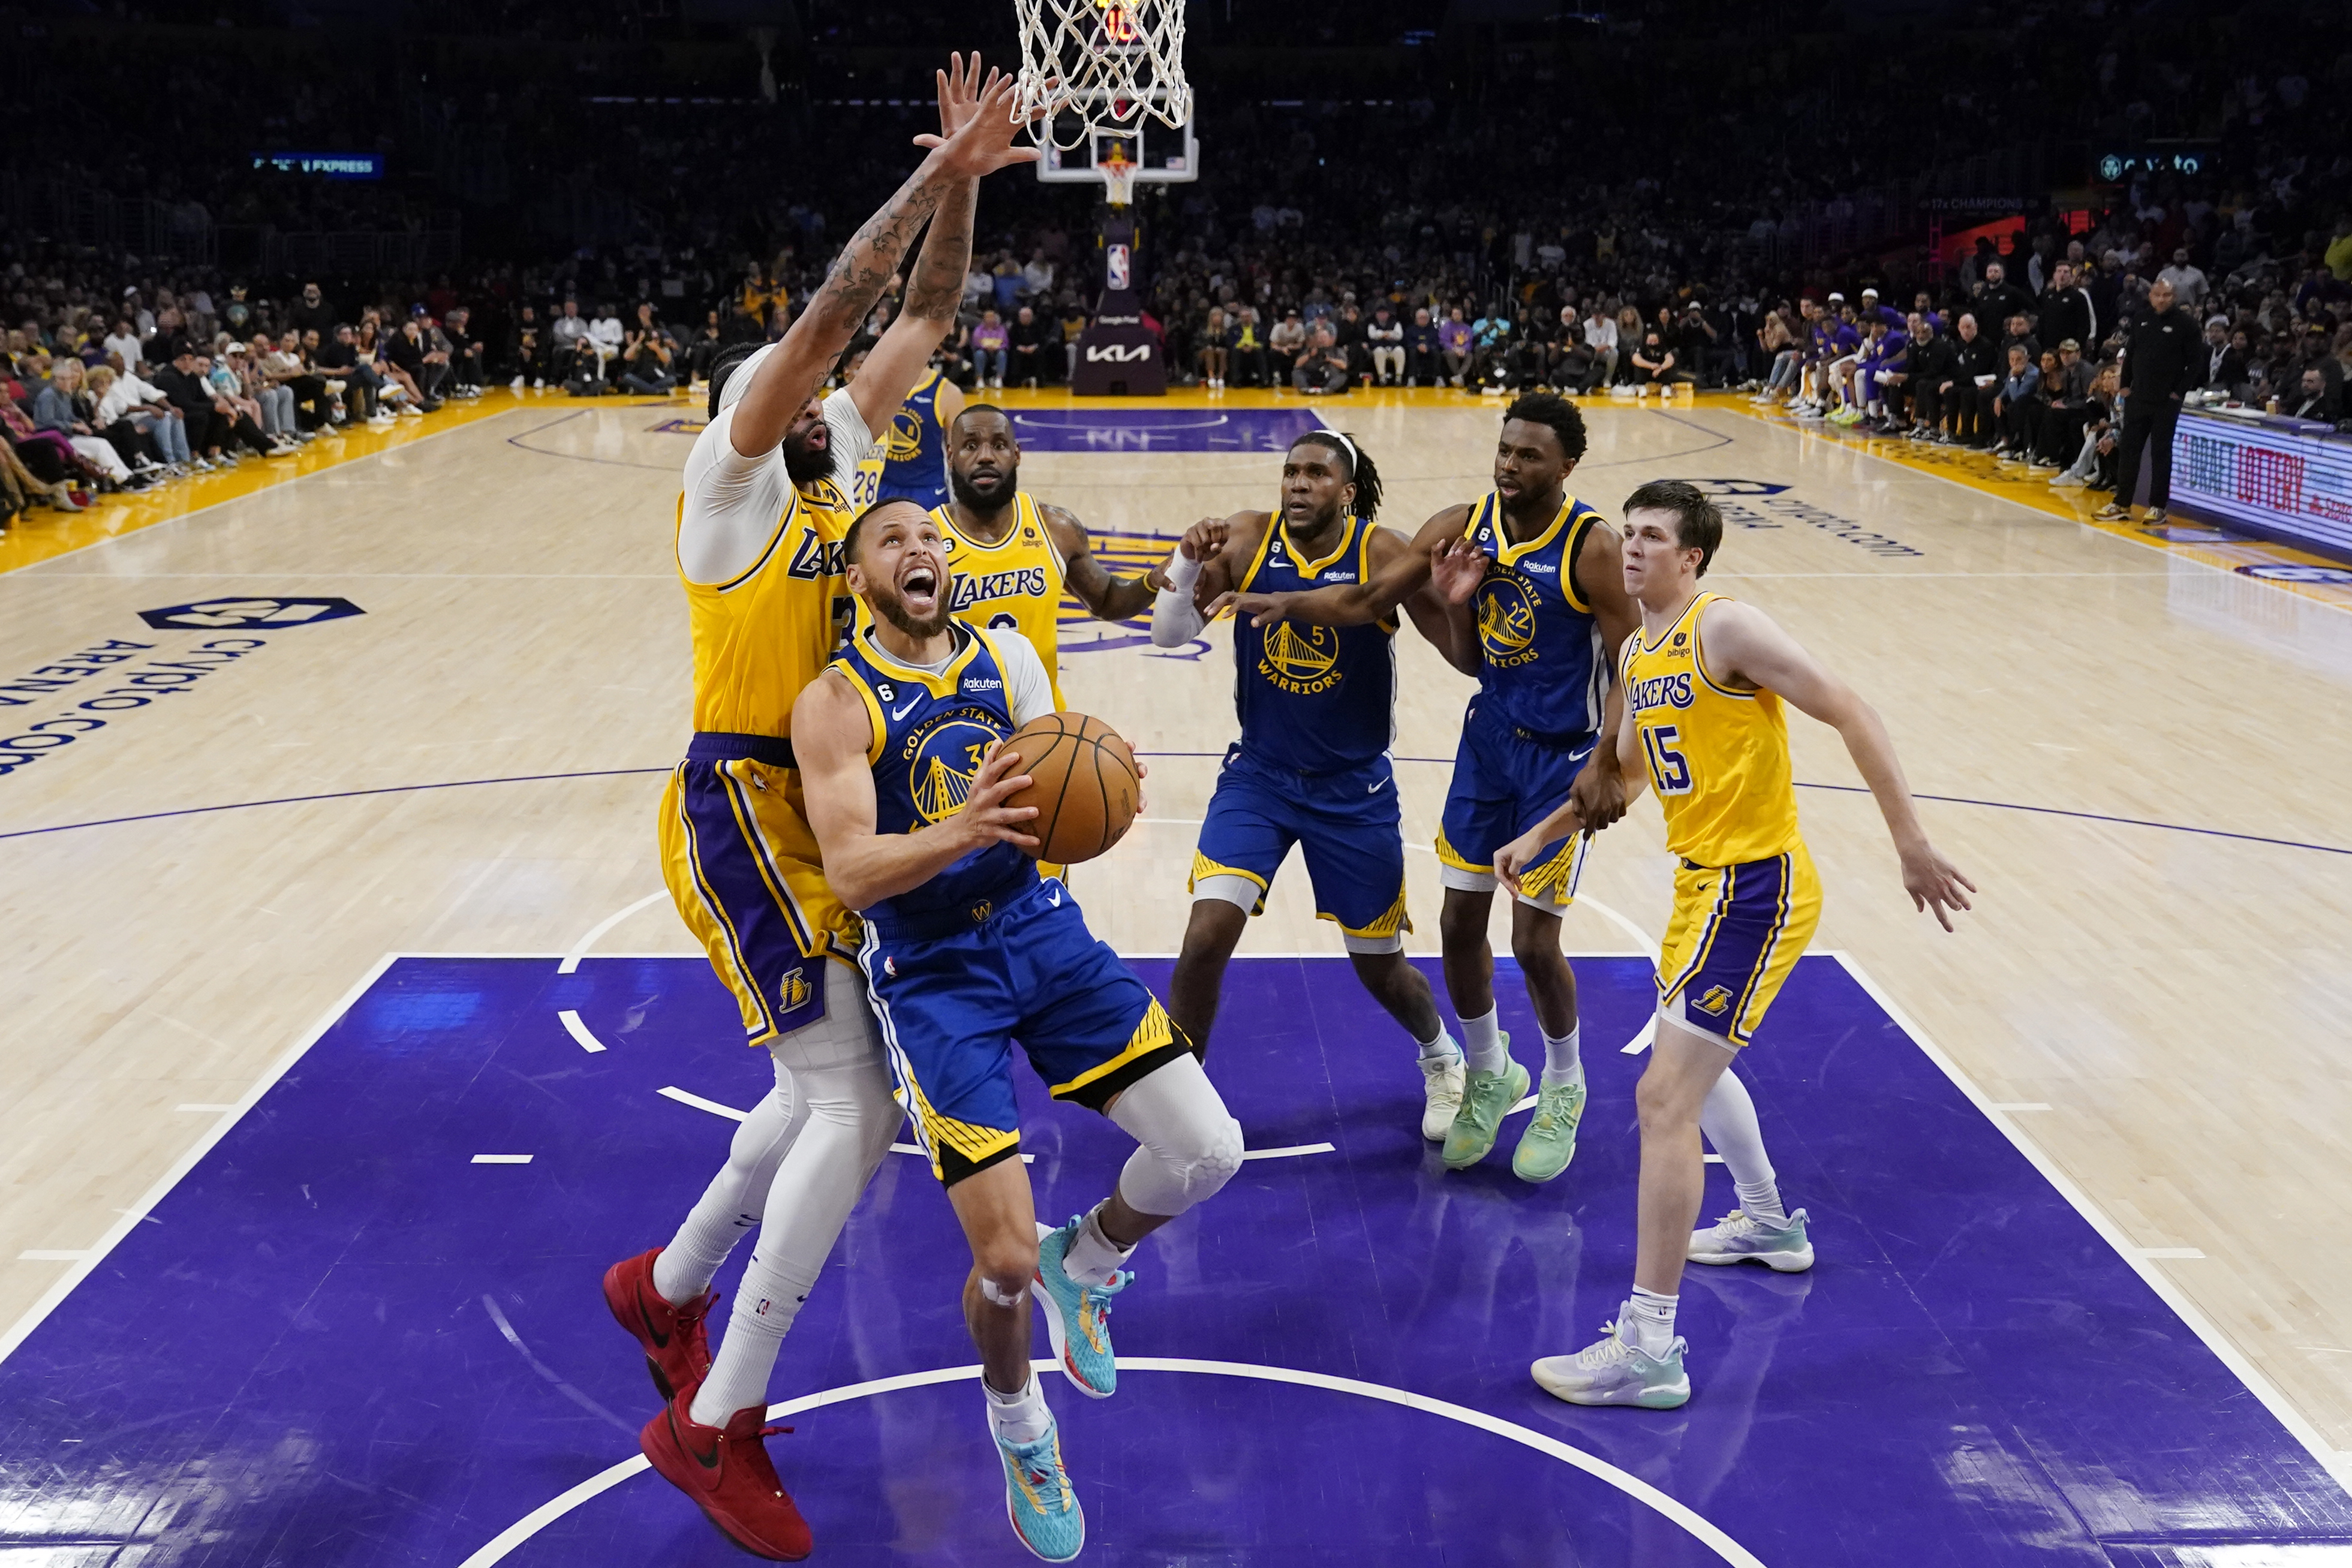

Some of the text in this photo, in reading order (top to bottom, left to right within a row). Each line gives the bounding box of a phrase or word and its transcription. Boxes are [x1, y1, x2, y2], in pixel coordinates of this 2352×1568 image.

[1951, 198, 2023, 209] CHAMPIONS
[853, 471, 877, 504] 28
[1271, 541, 1282, 553] 6
[1478, 528, 1491, 542] 6
[787, 526, 847, 581] LAK
[1324, 571, 1355, 580] Rakuten
[1523, 560, 1556, 573] Rakuten
[949, 567, 1047, 614] LAKERS
[1517, 576, 1542, 607] STATE
[1506, 601, 1530, 630] 22
[1312, 625, 1325, 646] 5
[1668, 648, 1691, 658] bibigo
[963, 678, 1002, 691] Rakuten
[1258, 658, 1343, 694] WARRIORS
[877, 684, 894, 702] 6
[903, 708, 1001, 760] GOLDEN STATE
[965, 741, 994, 776] 3
[1643, 724, 1694, 796] 15
